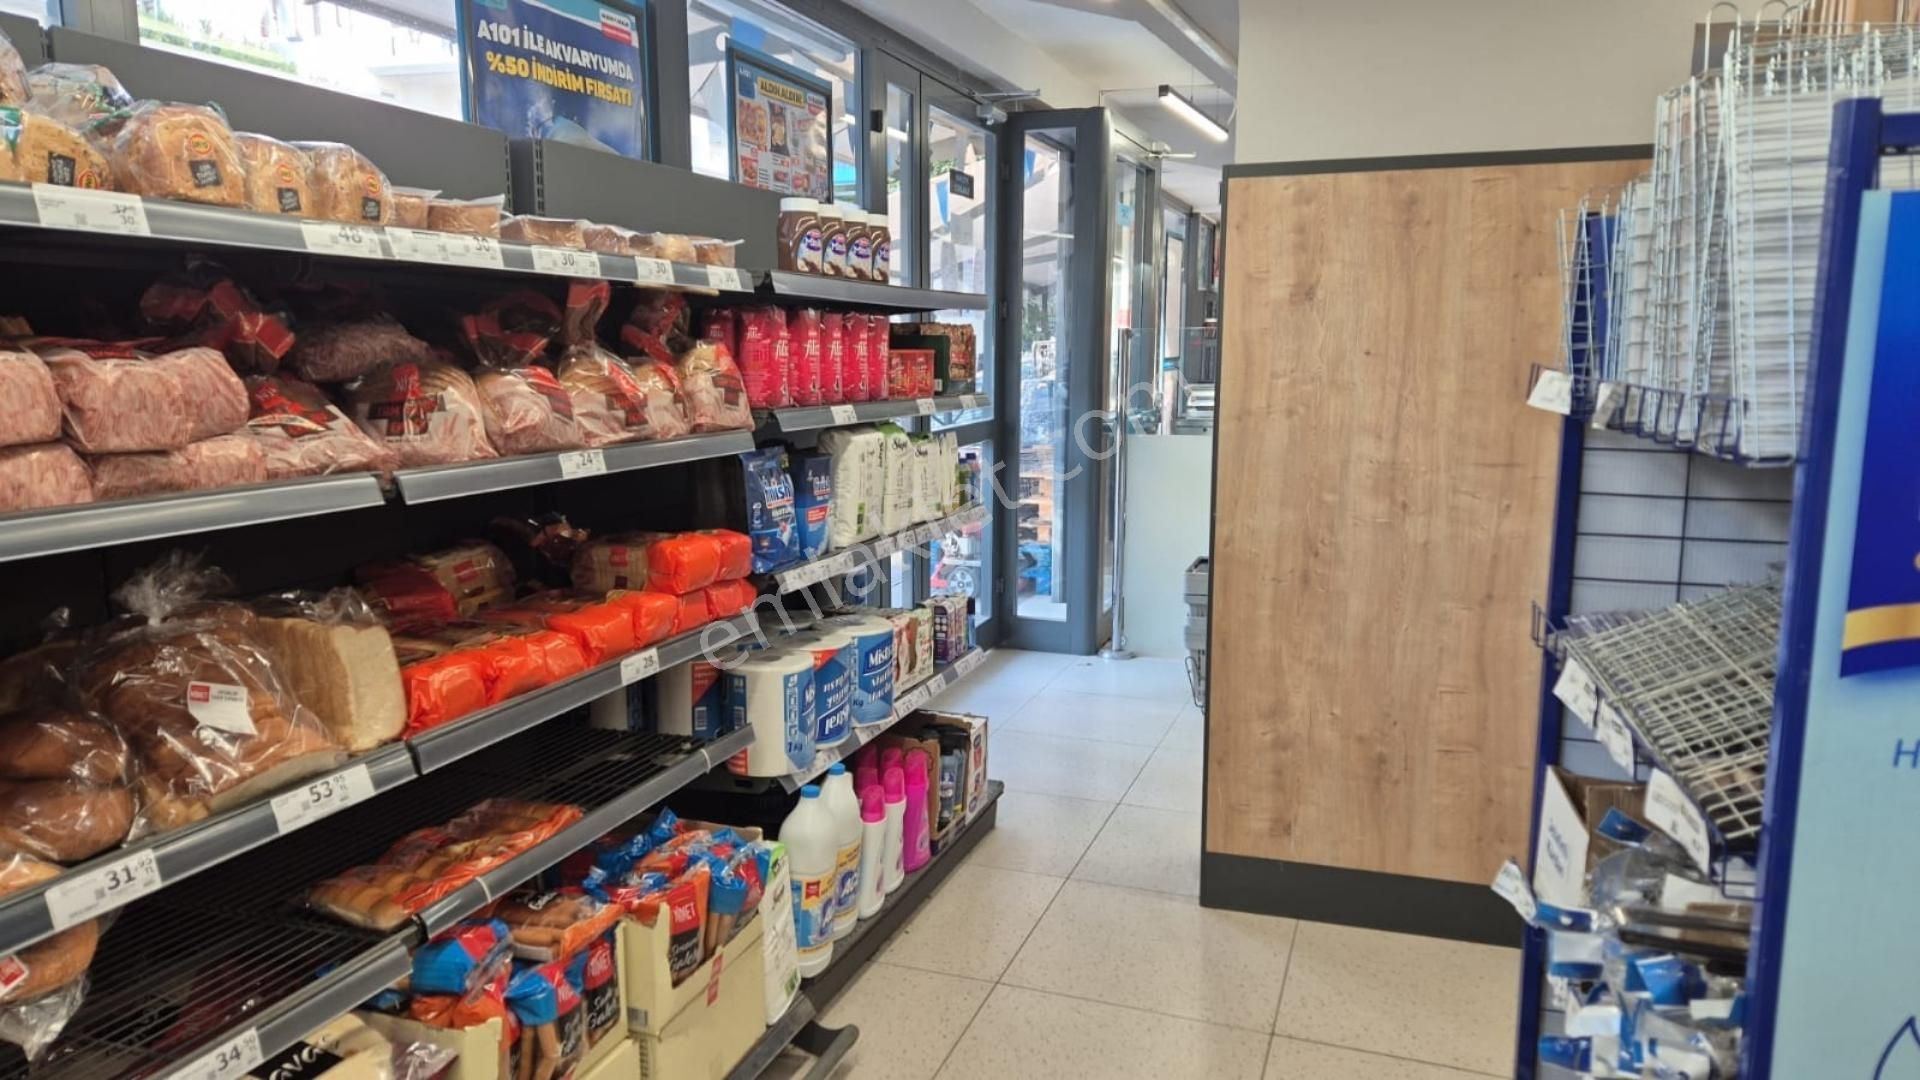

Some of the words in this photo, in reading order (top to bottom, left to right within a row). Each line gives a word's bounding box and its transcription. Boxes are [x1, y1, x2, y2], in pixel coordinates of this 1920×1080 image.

[477, 19, 520, 48] A101
[523, 25, 545, 53] İLE
[545, 38, 634, 82] AKVARYUMDA
[486, 51, 530, 78] %50
[531, 56, 584, 95] İNDİRİM
[309, 780, 333, 804] 53
[104, 865, 136, 891] 31
[215, 1045, 242, 1072] 34
